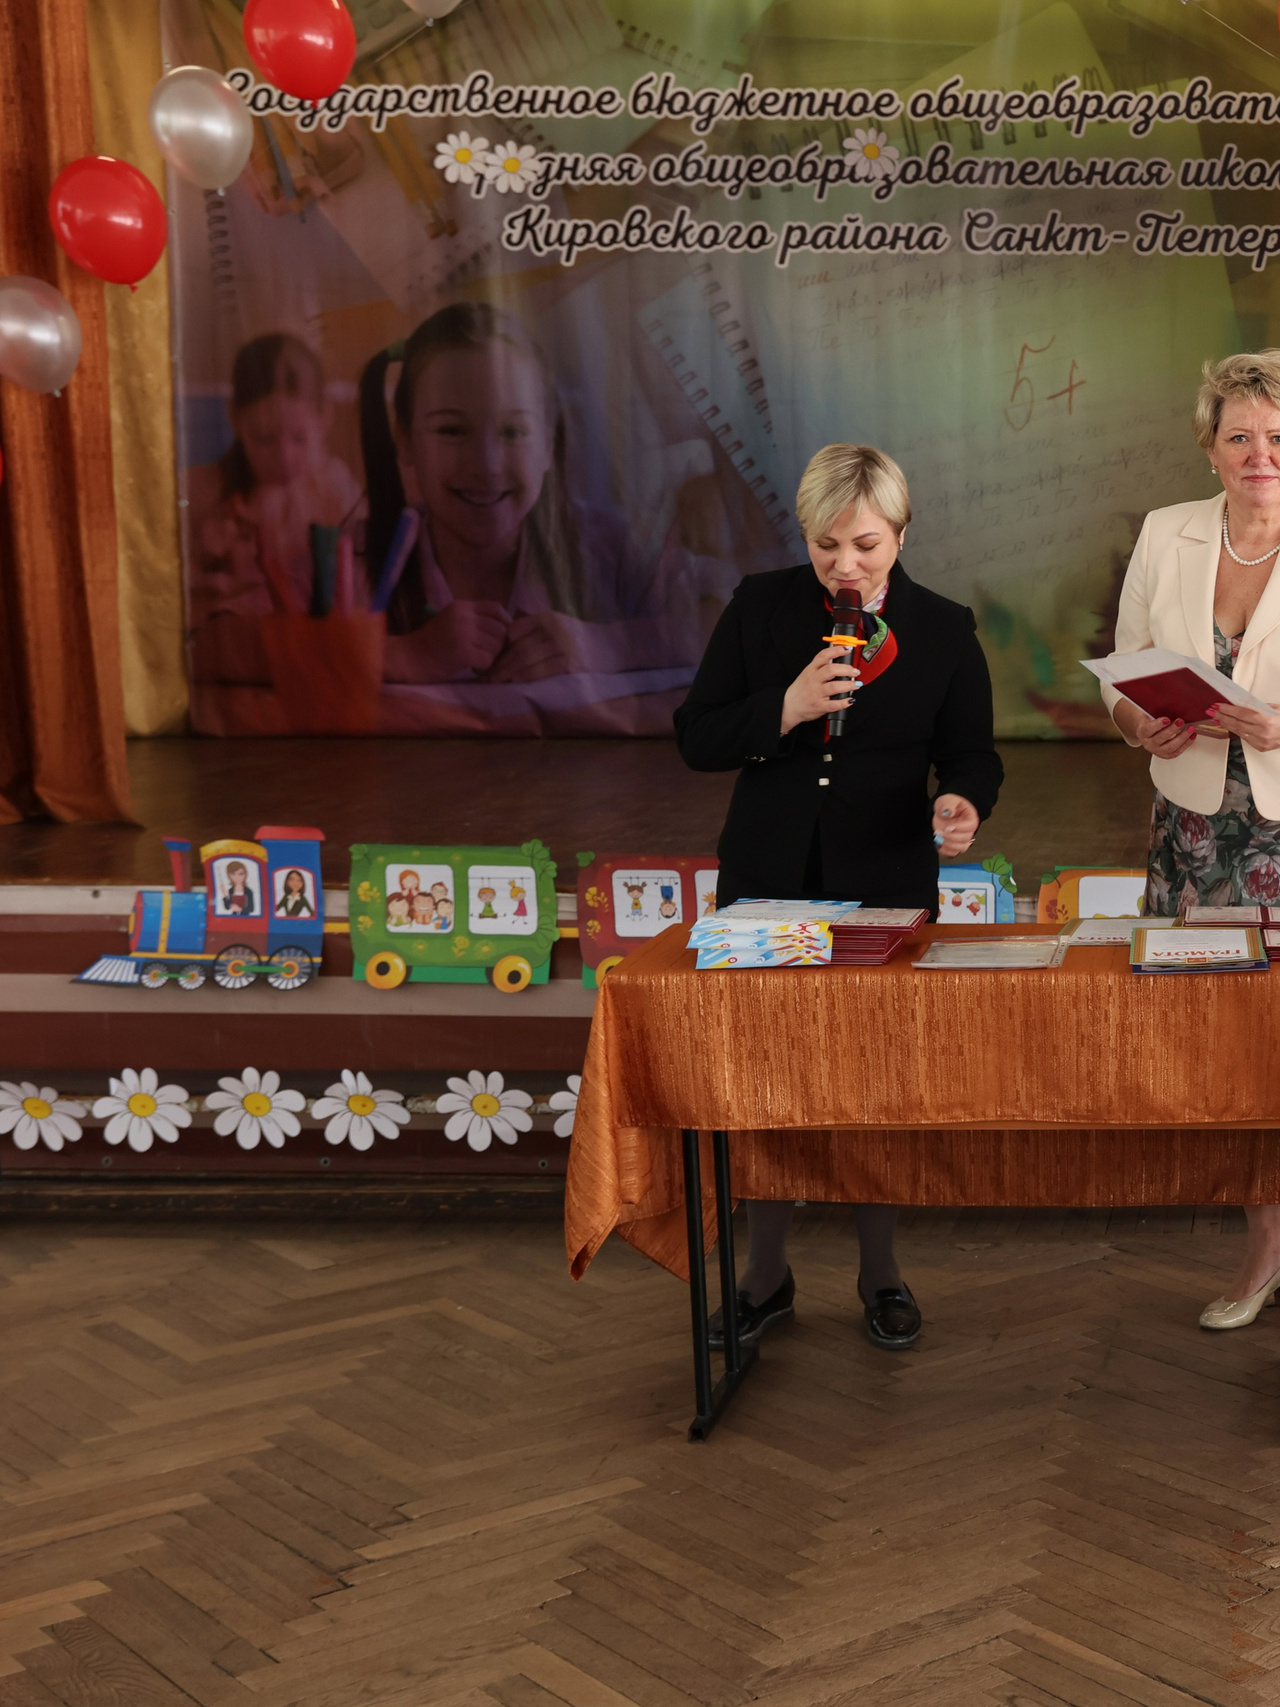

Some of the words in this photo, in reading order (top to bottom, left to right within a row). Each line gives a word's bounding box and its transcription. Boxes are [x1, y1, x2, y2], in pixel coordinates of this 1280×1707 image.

[631, 74, 900, 132] бюджетное
[505, 206, 773, 264] Кировского
[779, 216, 948, 266] района
[1152, 949, 1241, 957] ГРАМОТА
